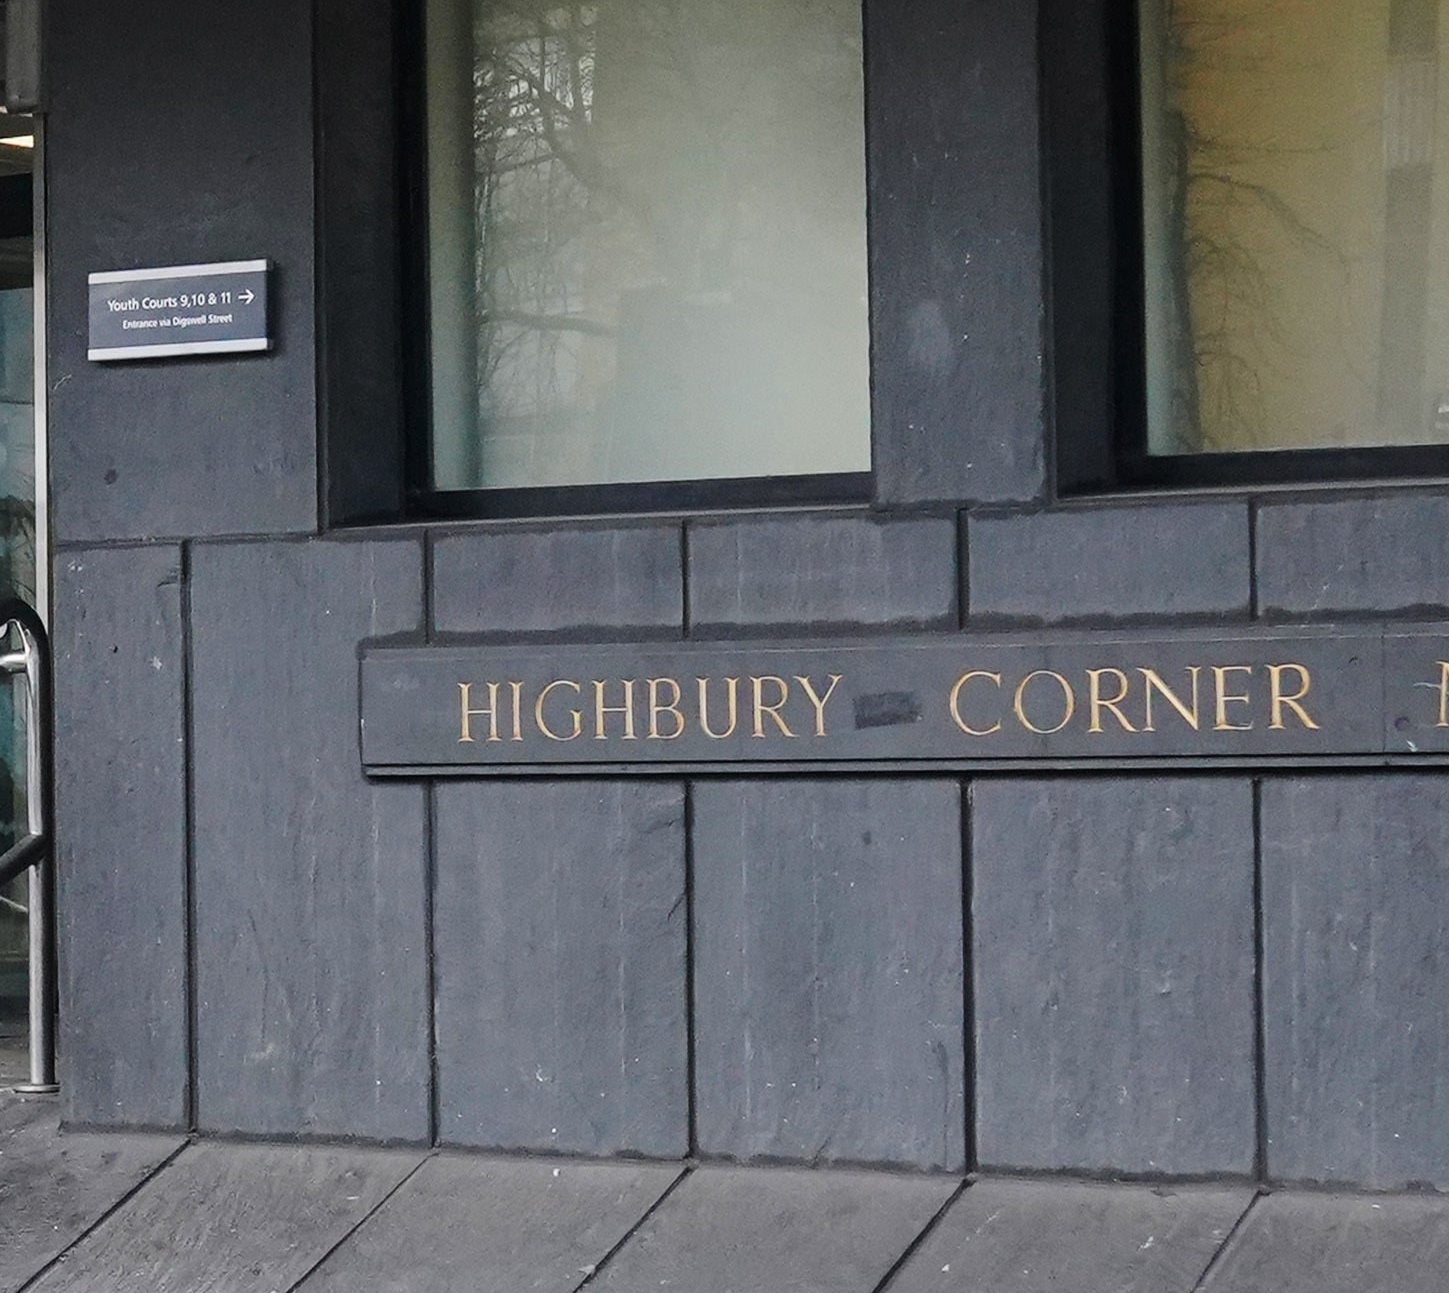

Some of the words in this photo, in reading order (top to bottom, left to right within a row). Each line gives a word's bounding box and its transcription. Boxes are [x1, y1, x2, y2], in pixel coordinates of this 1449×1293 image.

[107, 298, 139, 312] Youth
[142, 296, 178, 310] Courts
[208, 292, 217, 305] &
[220, 291, 231, 304] 11
[122, 319, 157, 330] Entrance
[159, 318, 171, 327] via
[208, 313, 233, 324] Street
[455, 673, 843, 745] HIGHBURY
[949, 663, 1321, 733] CORNER
